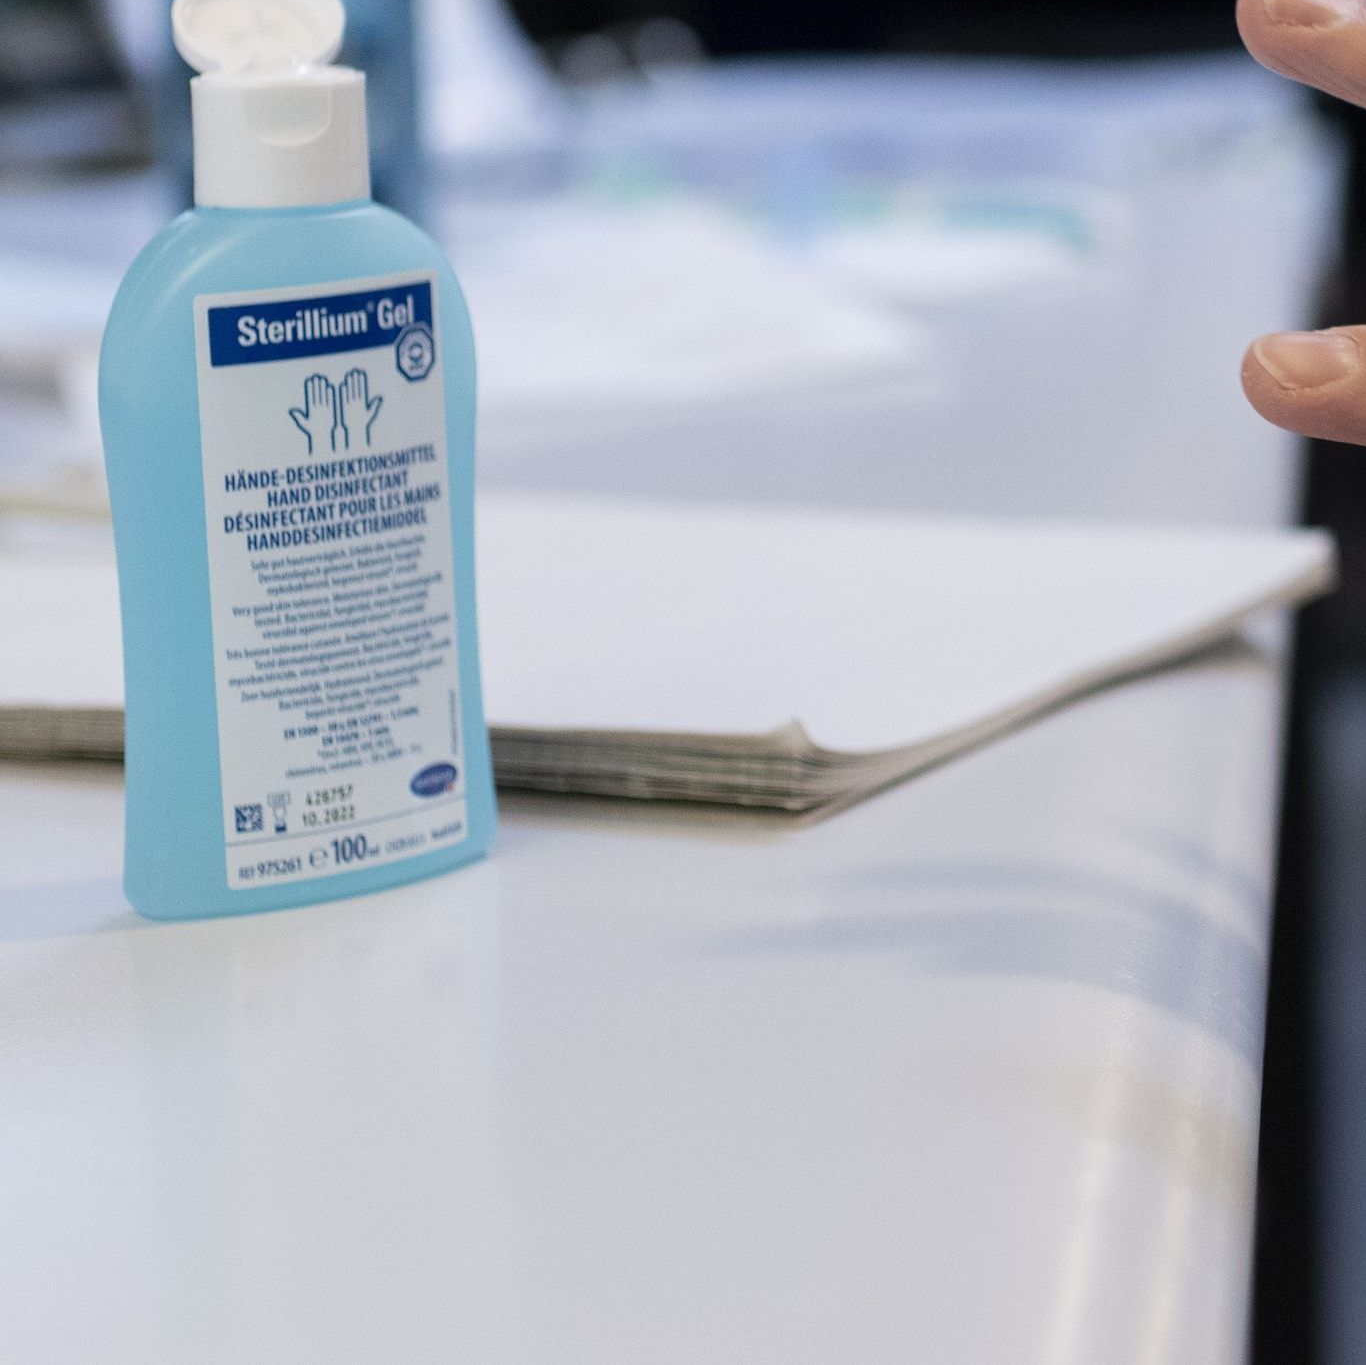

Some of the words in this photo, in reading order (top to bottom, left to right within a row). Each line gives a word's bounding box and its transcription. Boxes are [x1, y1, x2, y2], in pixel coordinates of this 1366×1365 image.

[236, 307, 369, 347] Sterillium
[377, 294, 415, 330] Gel
[224, 443, 436, 492] HÄNDE-DESINFEKTIONSMITTEL
[267, 486, 311, 508] HAND
[314, 470, 409, 501] DISINFECTANT
[223, 502, 336, 533] DÉSINFECTANT
[339, 495, 377, 519] POUR
[379, 491, 400, 511] LES
[404, 483, 441, 505] MAINS
[246, 506, 428, 552] HANDDESINFECTIEMIDDEL
[256, 856, 302, 879] 975261
[331, 835, 367, 865] 100
